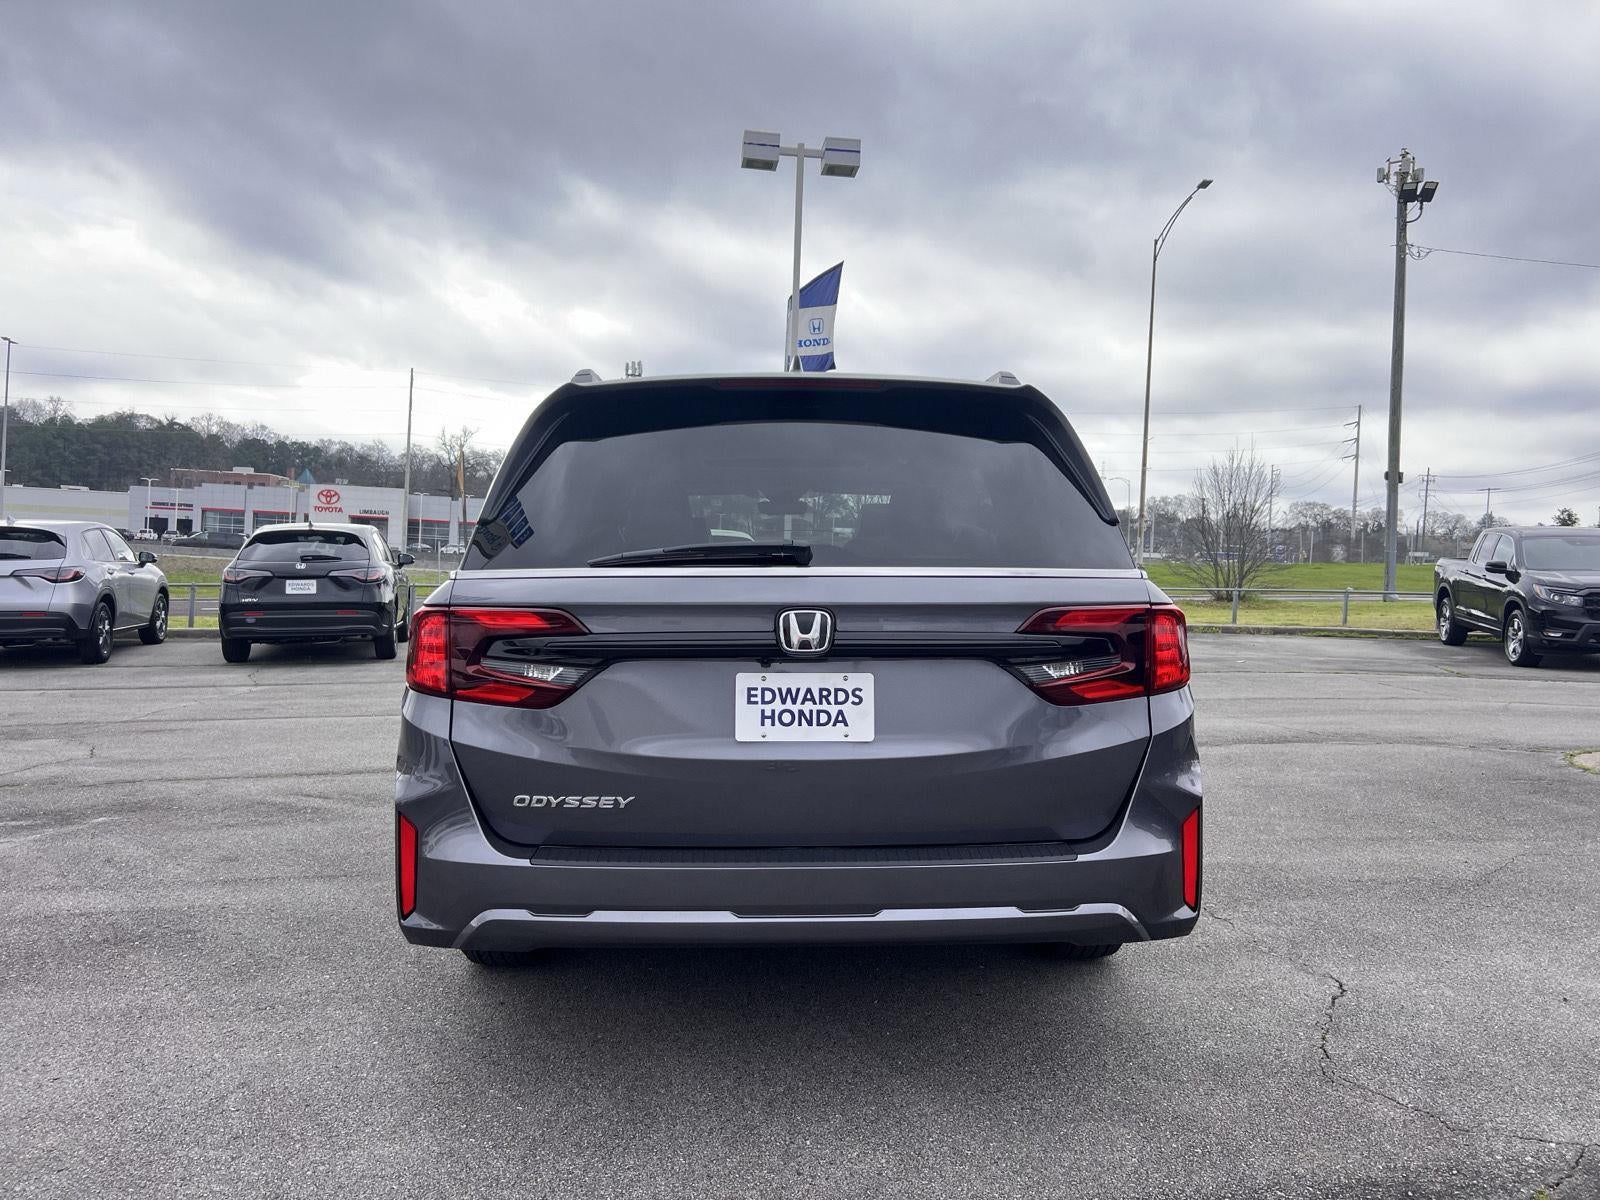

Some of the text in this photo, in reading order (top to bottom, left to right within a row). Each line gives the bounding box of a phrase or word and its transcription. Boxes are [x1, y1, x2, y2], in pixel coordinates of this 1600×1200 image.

[313, 505, 344, 513] TOYOTA
[746, 686, 864, 706] EDWARDS
[760, 708, 849, 727] HONDA
[512, 794, 636, 809] ODYSSEY
